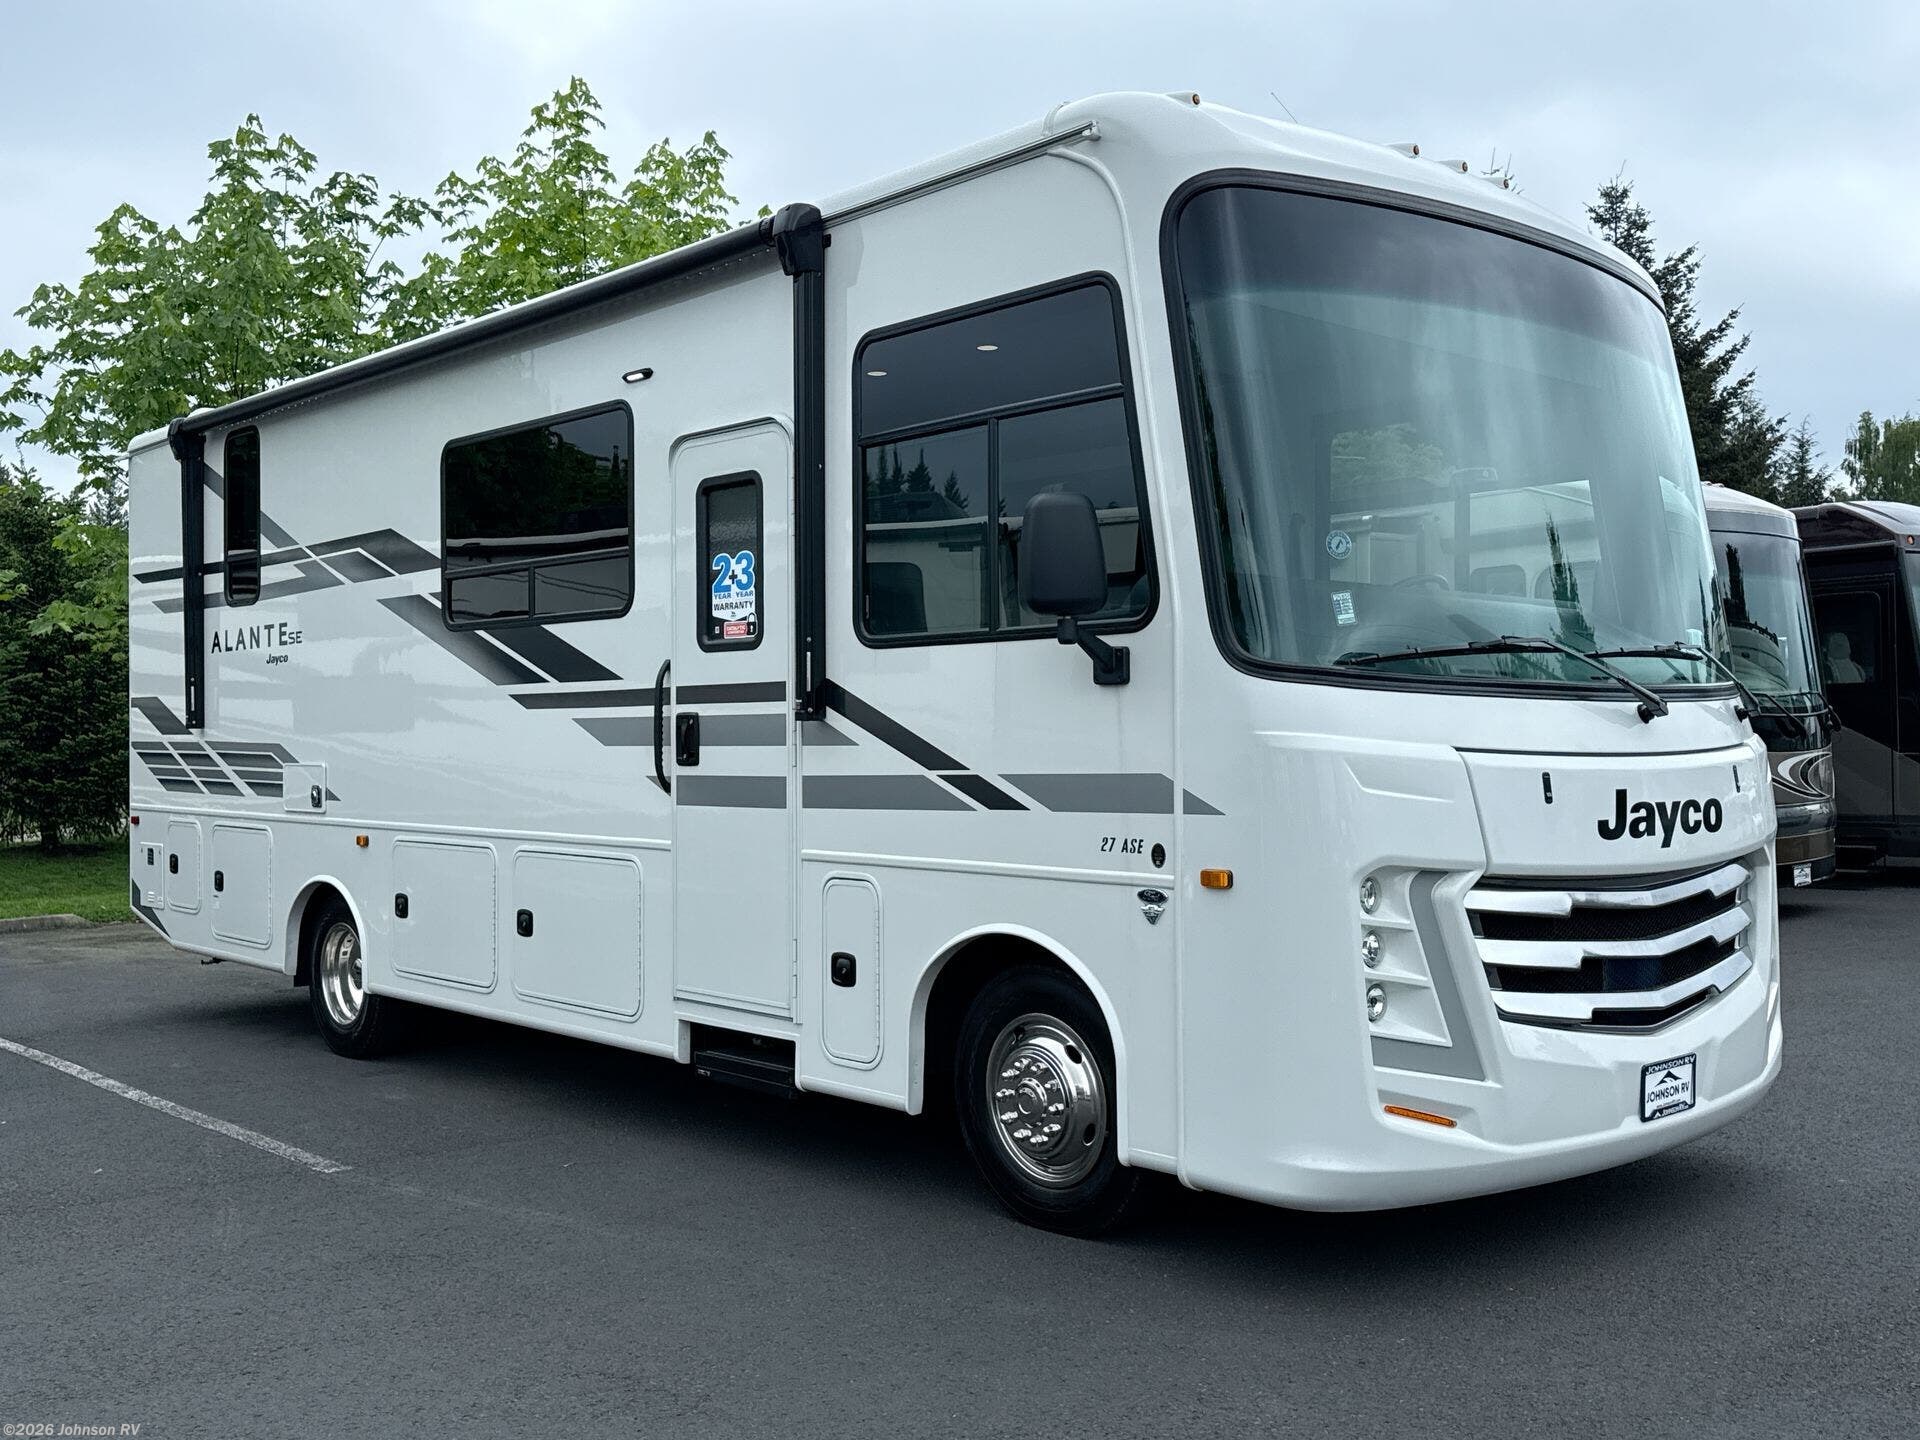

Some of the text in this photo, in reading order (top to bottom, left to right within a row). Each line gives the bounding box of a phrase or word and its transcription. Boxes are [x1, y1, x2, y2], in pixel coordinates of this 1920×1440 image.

[714, 590, 754, 600] YEAR YEAR
[713, 600, 754, 611] WARRANTY
[211, 622, 288, 654] ALANTE
[265, 653, 289, 666] Jayco
[1597, 788, 1723, 849] Jayco
[1100, 836, 1144, 855] 27 ASE
[1645, 1054, 1696, 1075] JOHNSON RV
[1646, 1084, 1680, 1104] JOHNSON
[1680, 1081, 1690, 1094] RV
